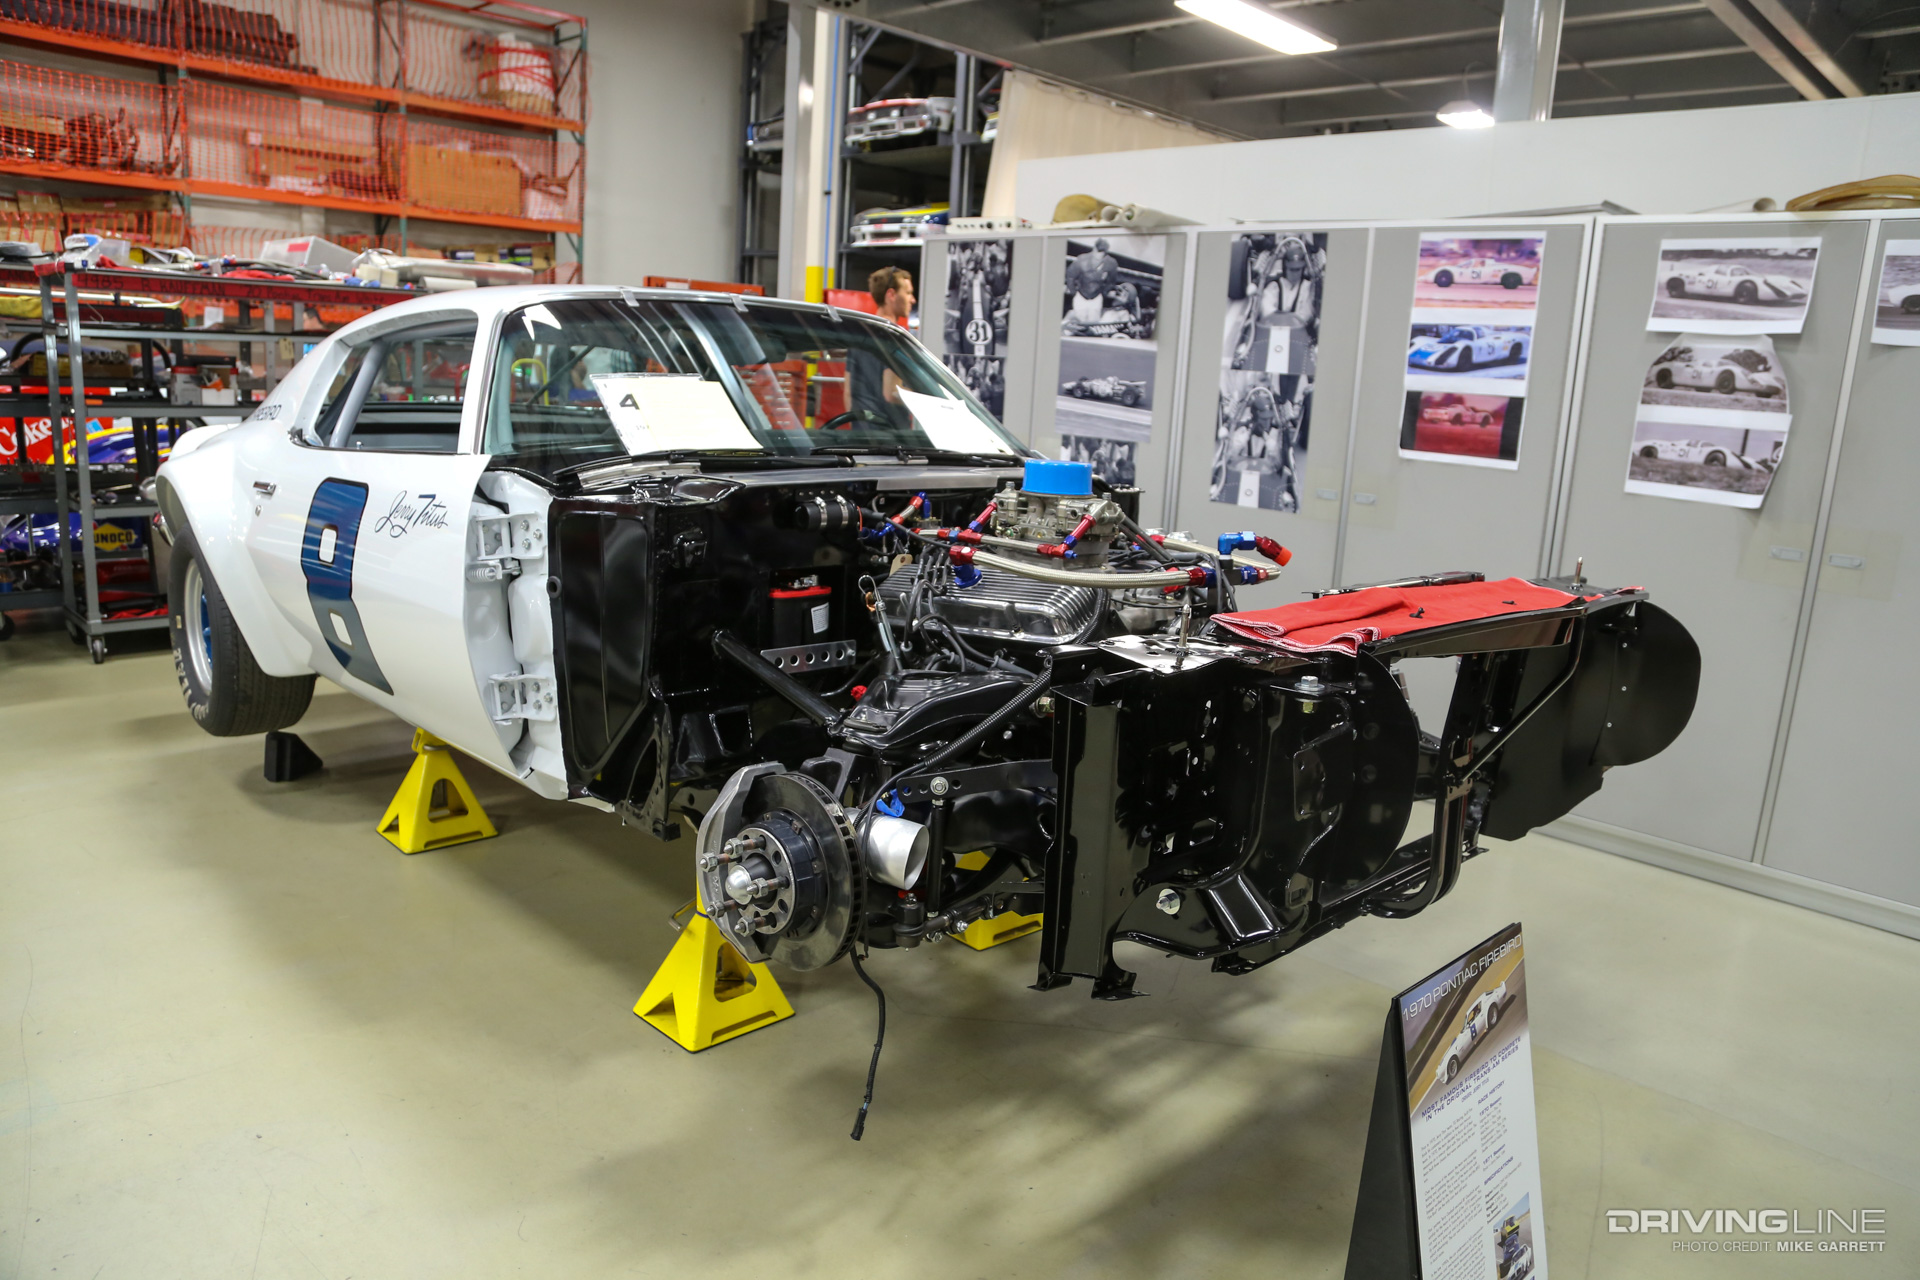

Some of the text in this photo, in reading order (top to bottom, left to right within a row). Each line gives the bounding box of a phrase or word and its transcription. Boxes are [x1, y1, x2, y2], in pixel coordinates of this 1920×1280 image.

[969, 321, 989, 342] 31
[619, 393, 640, 410] 4
[94, 531, 133, 544] UNOCO
[1403, 934, 1522, 1020] 1970 PONTIAC FIREBIRD
[1421, 1036, 1521, 1118] MOST FAMOUS FIREBIRD TO COMPETE
[1425, 1045, 1519, 1122] IN THE ORIGINAL TRANS-AM SERIES
